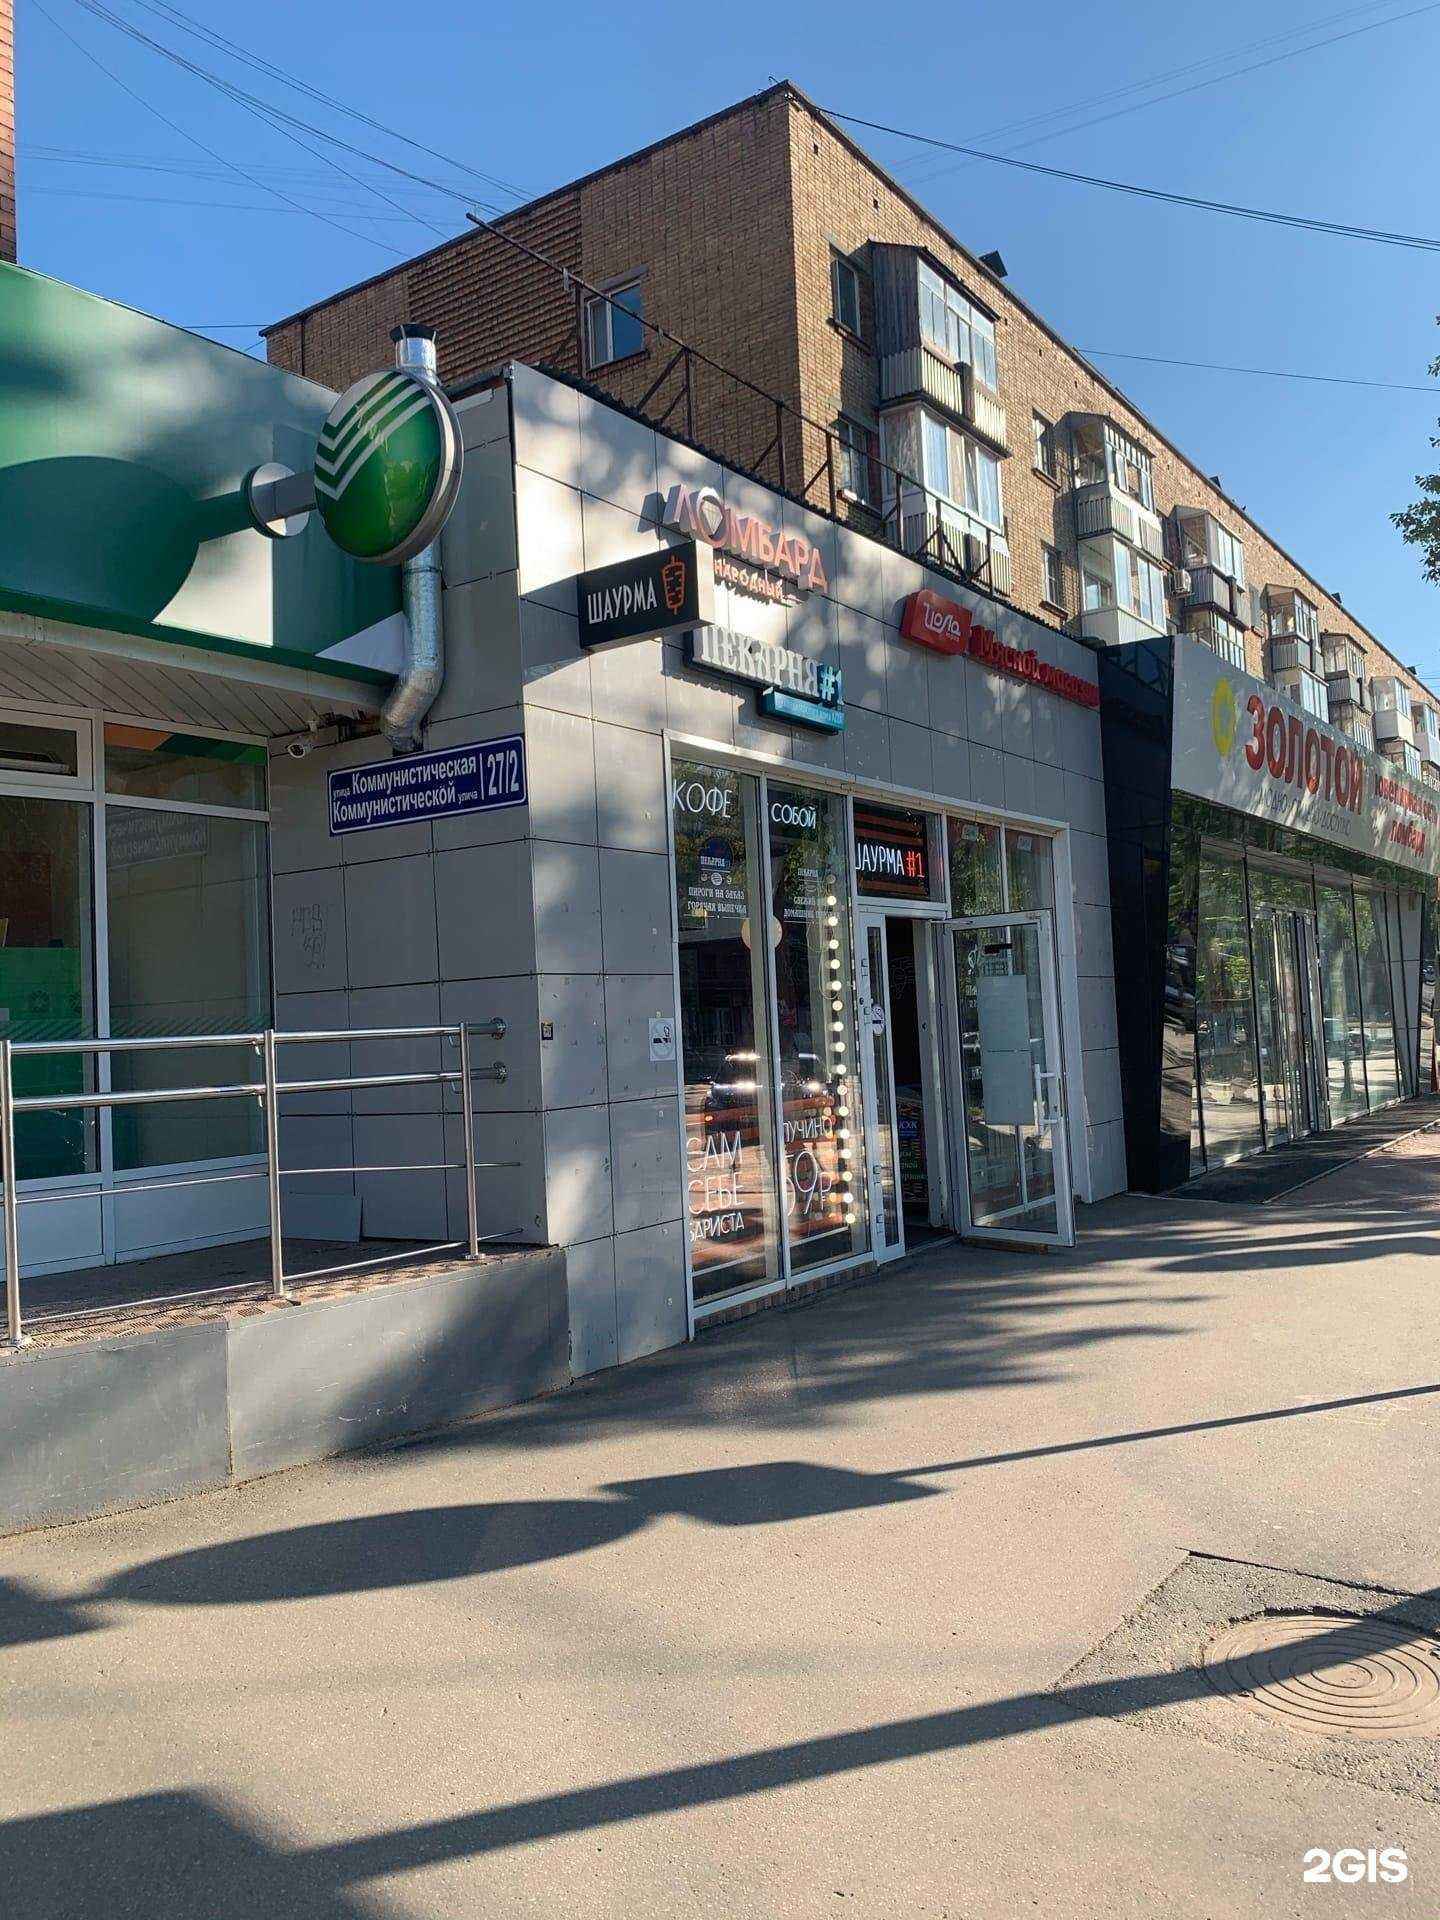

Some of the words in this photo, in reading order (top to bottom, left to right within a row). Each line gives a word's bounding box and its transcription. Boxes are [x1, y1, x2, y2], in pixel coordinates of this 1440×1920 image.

[659, 483, 830, 593] ЛОМБАРД
[586, 576, 659, 625] ШАУРМА
[352, 755, 477, 795] Коммунистическая
[487, 750, 520, 796] 27/2
[671, 779, 733, 819] КОФЕ
[770, 802, 817, 830] СОБОЙ
[905, 851, 926, 878] #1
[686, 1130, 743, 1172] САМ
[783, 1115, 832, 1143] ПУЧИНО
[688, 1171, 744, 1214] СЕБЕ
